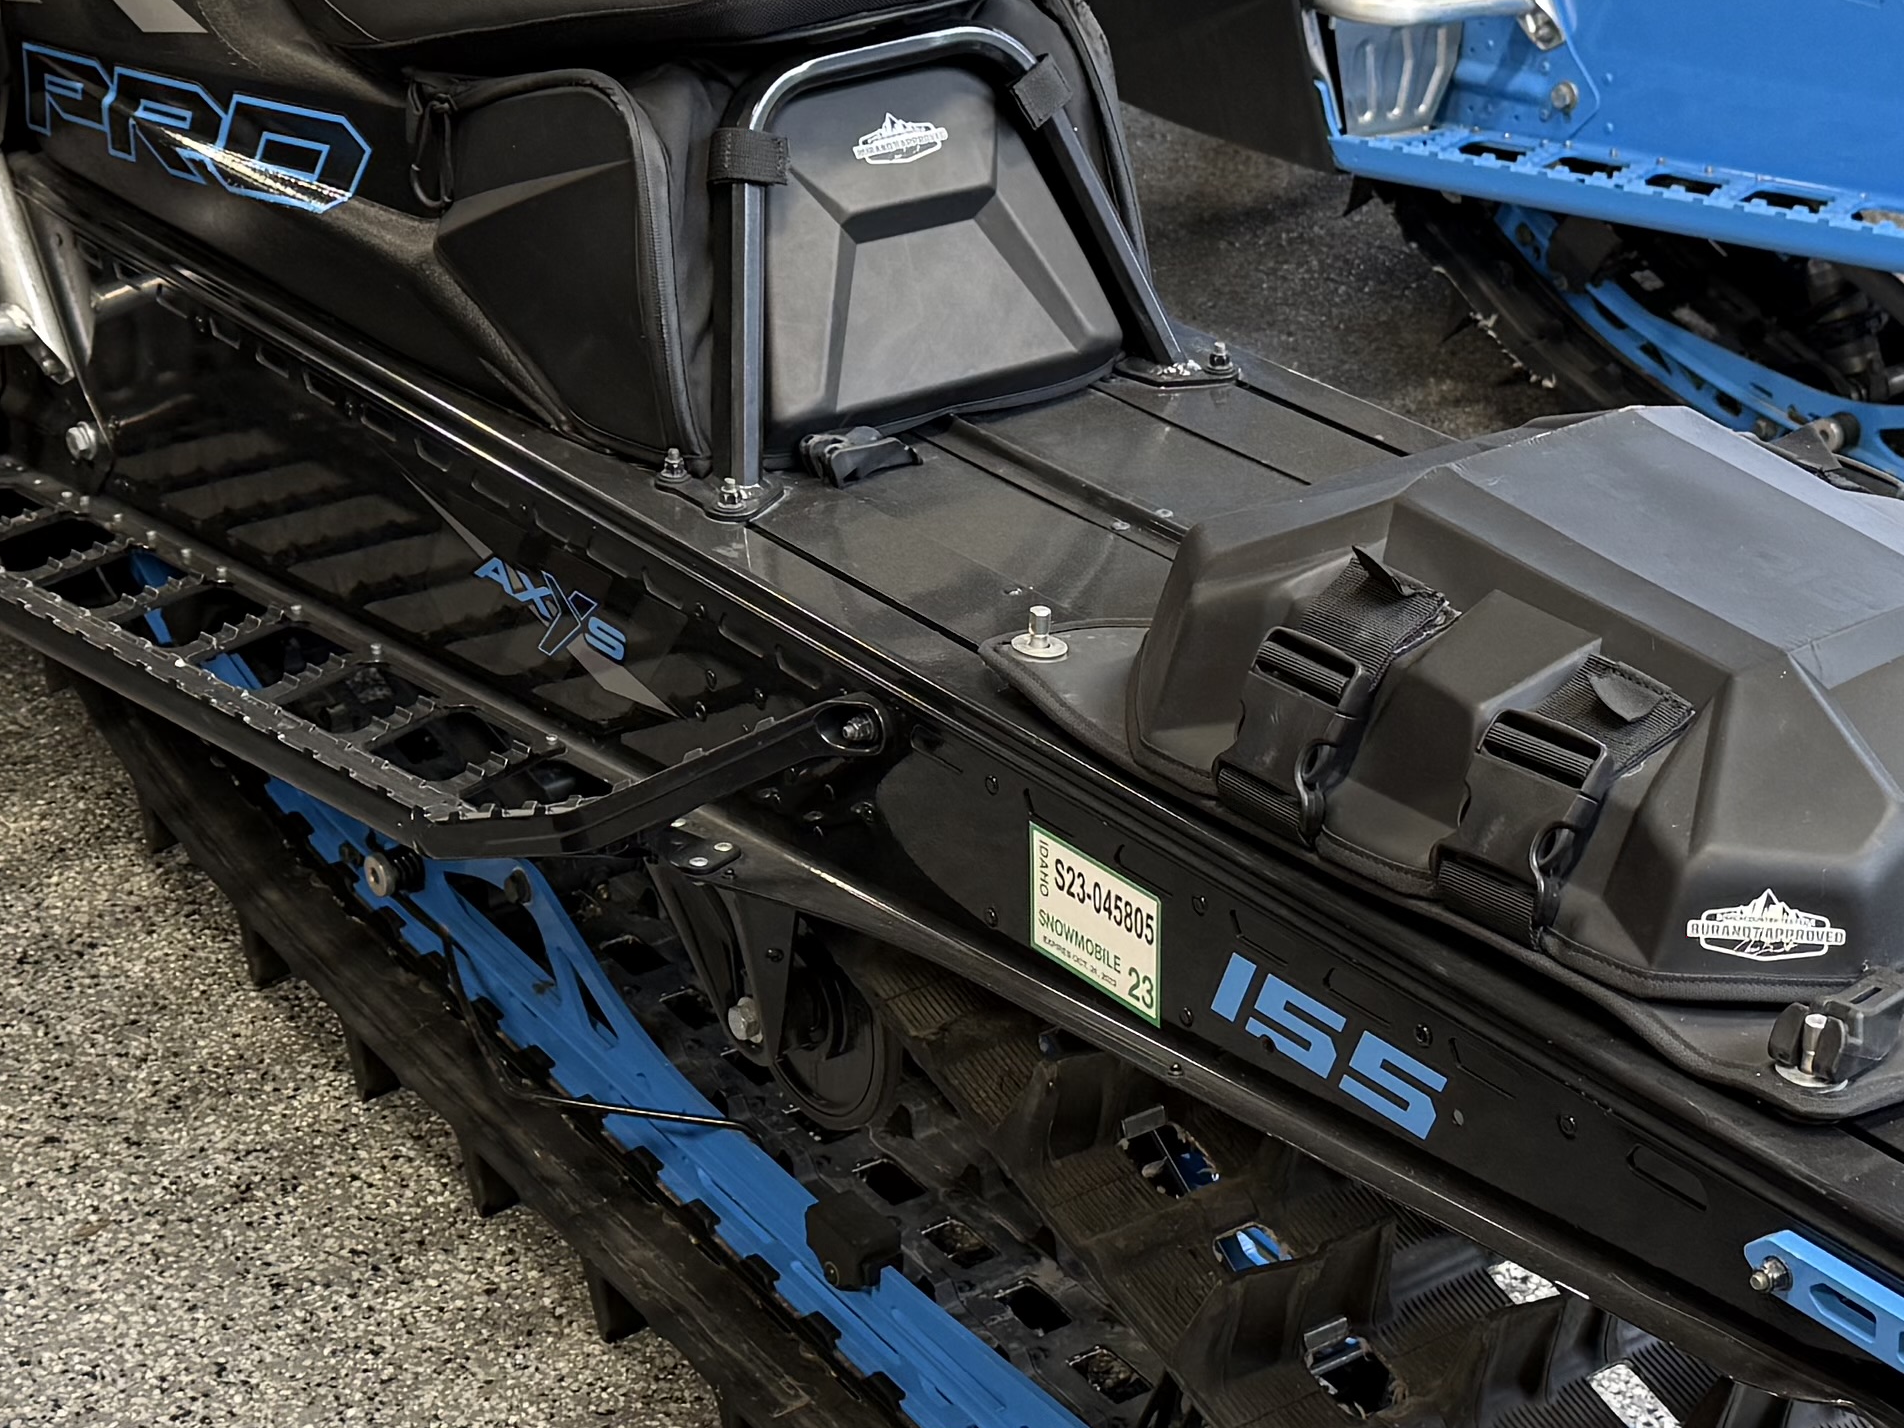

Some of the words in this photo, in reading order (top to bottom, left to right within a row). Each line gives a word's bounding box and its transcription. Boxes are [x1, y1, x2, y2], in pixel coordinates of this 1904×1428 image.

[23, 42, 373, 214] PRO
[475, 556, 626, 662] AXYS
[1039, 839, 1050, 898] IDAHO
[1054, 858, 1155, 946] S23-045805
[1039, 909, 1121, 974] SNOWMOBILE
[1764, 926, 1845, 944] APPROVED
[1127, 966, 1155, 1010] 23
[1210, 952, 1448, 1140] 155
